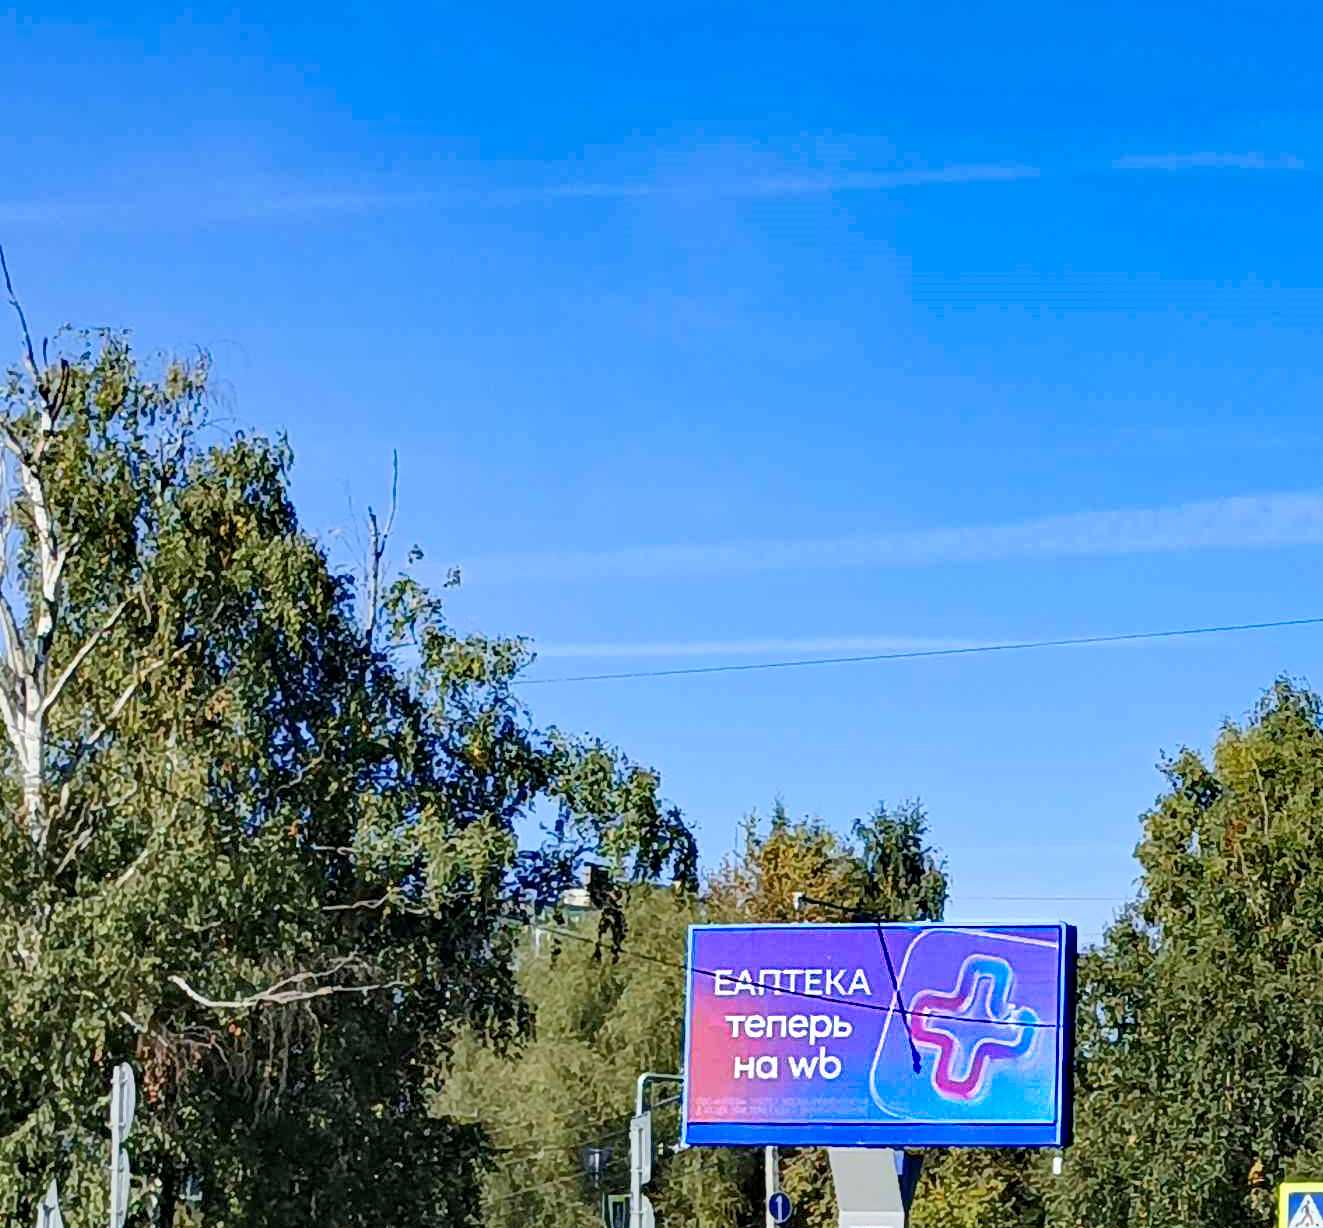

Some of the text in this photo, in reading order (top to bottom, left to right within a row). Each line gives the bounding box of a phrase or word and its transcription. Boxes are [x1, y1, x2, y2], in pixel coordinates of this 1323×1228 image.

[713, 968, 872, 996] ЕАПТЕКА
[725, 1014, 853, 1044] теперь
[734, 1048, 841, 1080] на wb
